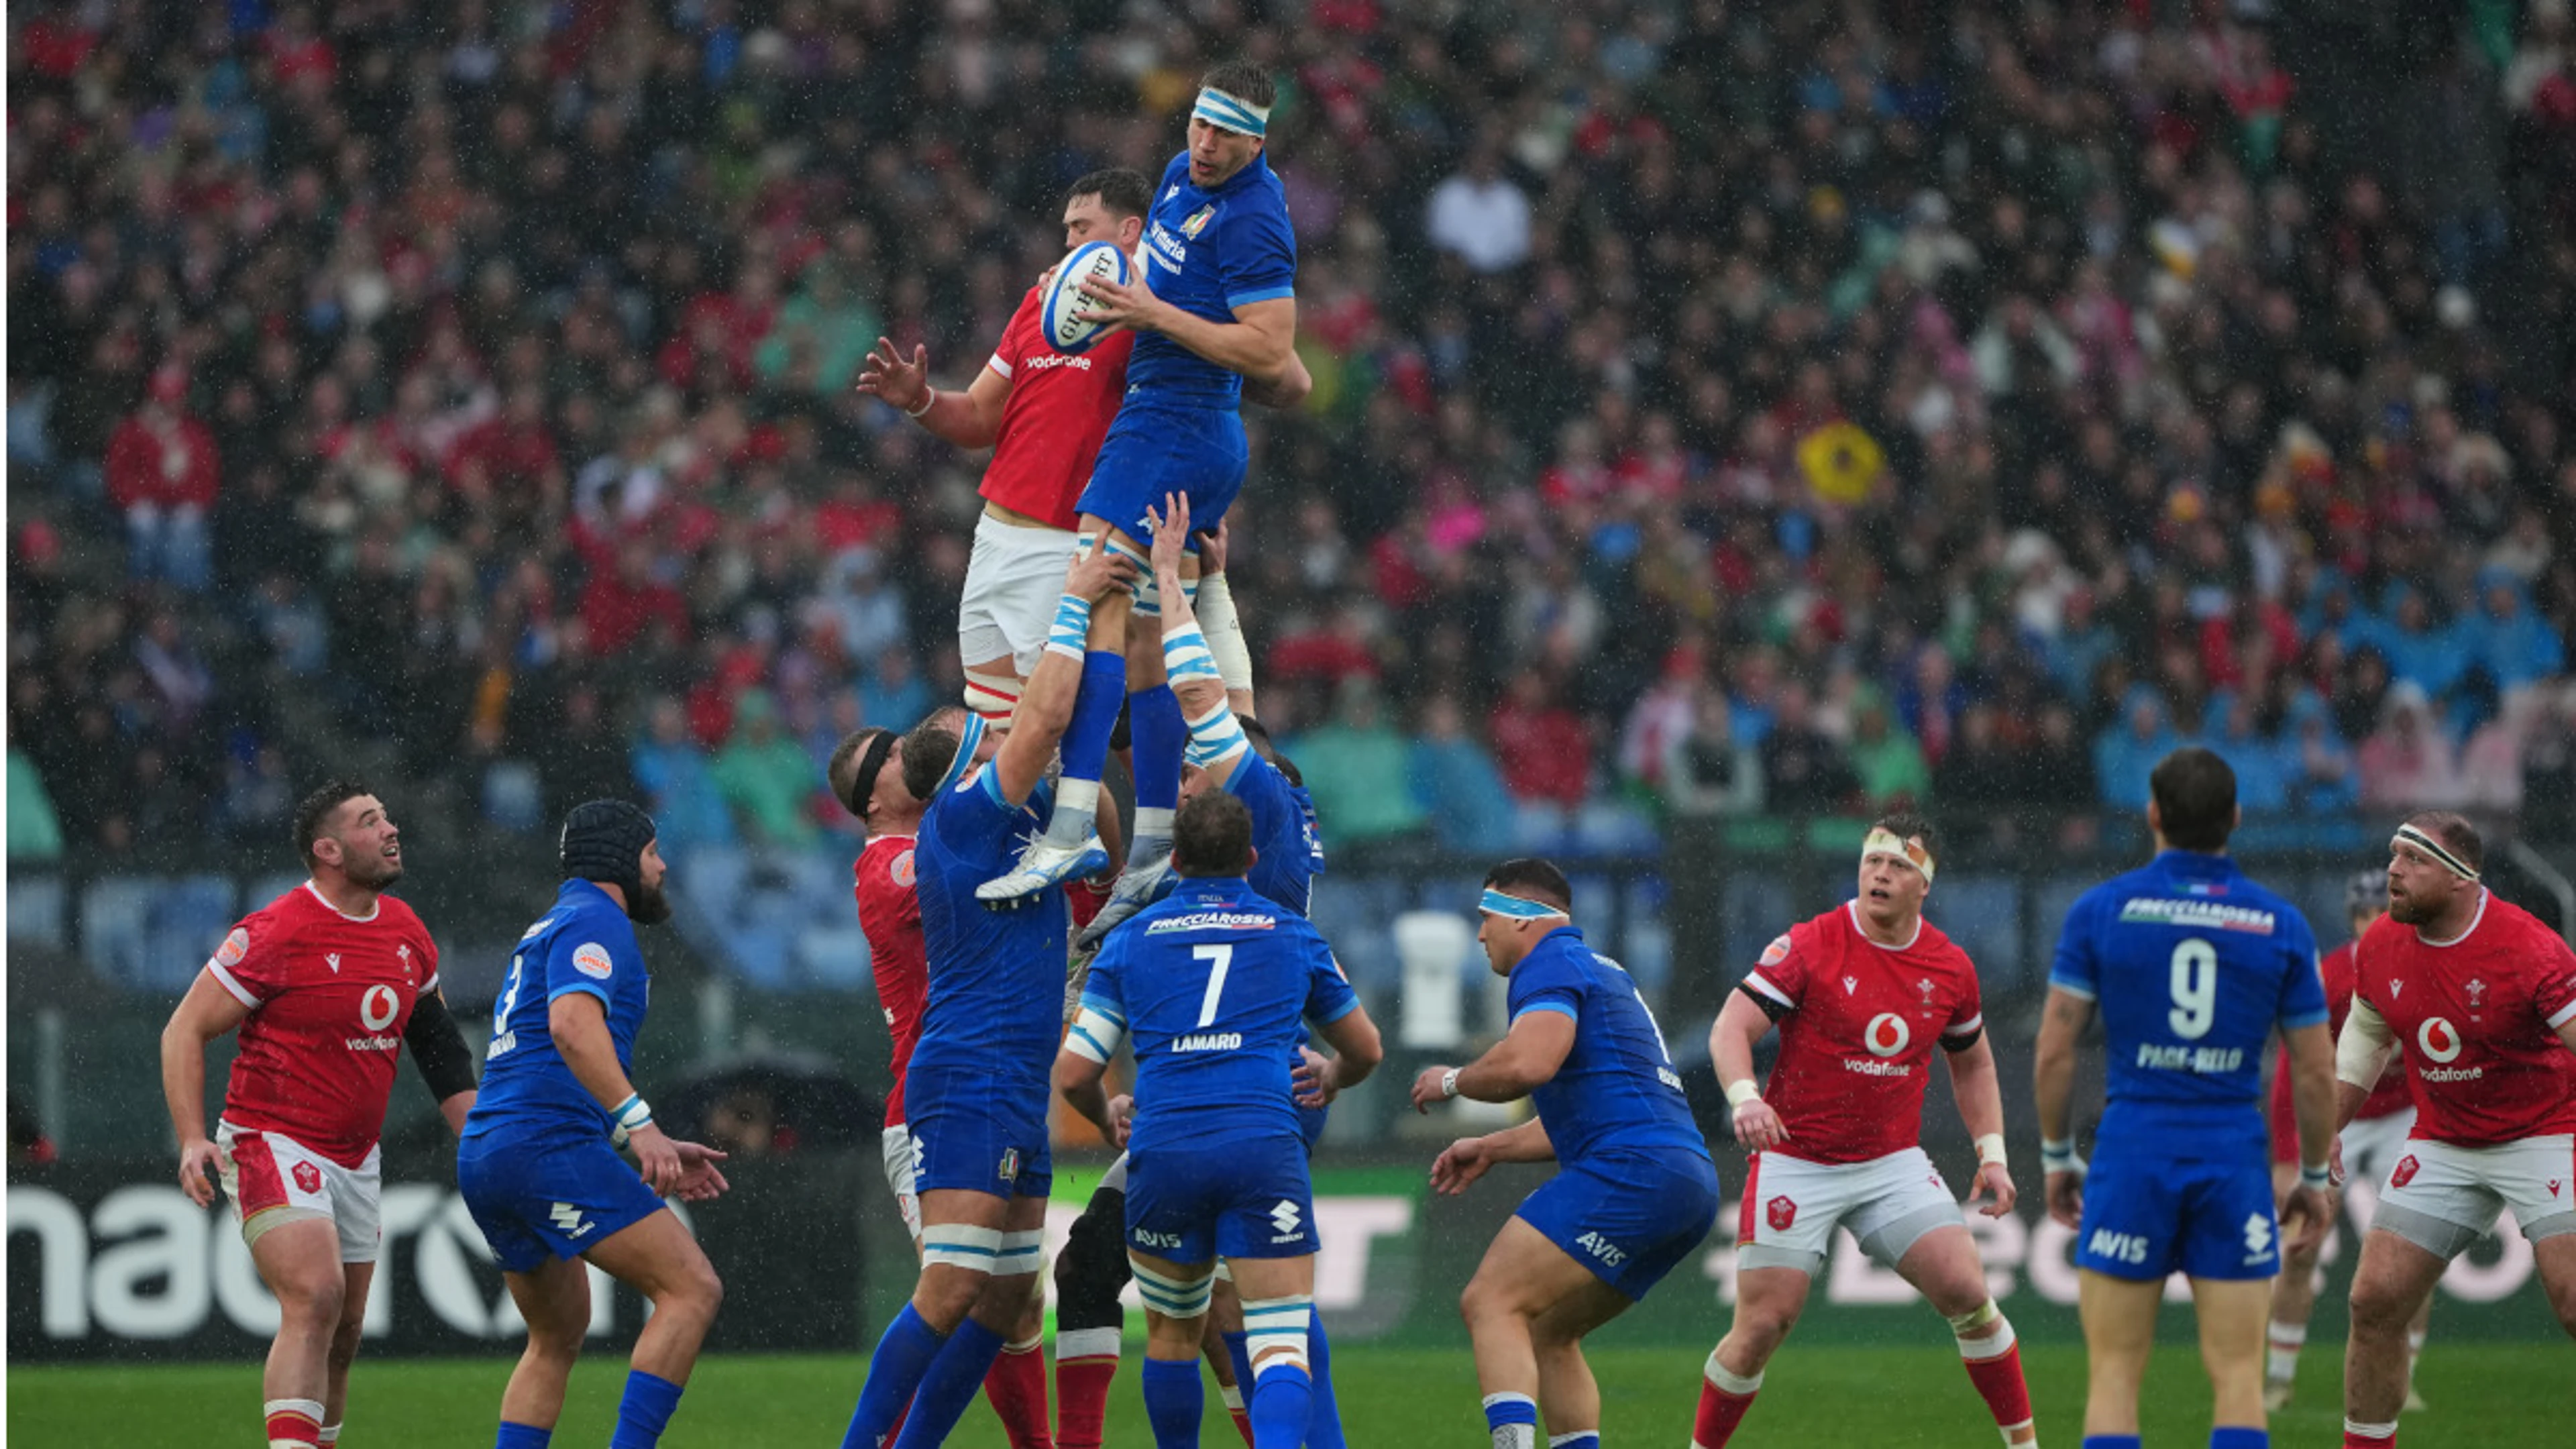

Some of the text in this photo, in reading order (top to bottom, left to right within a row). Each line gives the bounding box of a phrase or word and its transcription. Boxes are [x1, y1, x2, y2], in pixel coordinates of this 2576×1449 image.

[1193, 944, 1232, 1028] 7
[2168, 938, 2217, 1040] 9
[1171, 1032, 1242, 1053] LAMARO
[1575, 1231, 1627, 1267] AVIS
[2088, 1228, 2147, 1265] AVIS
